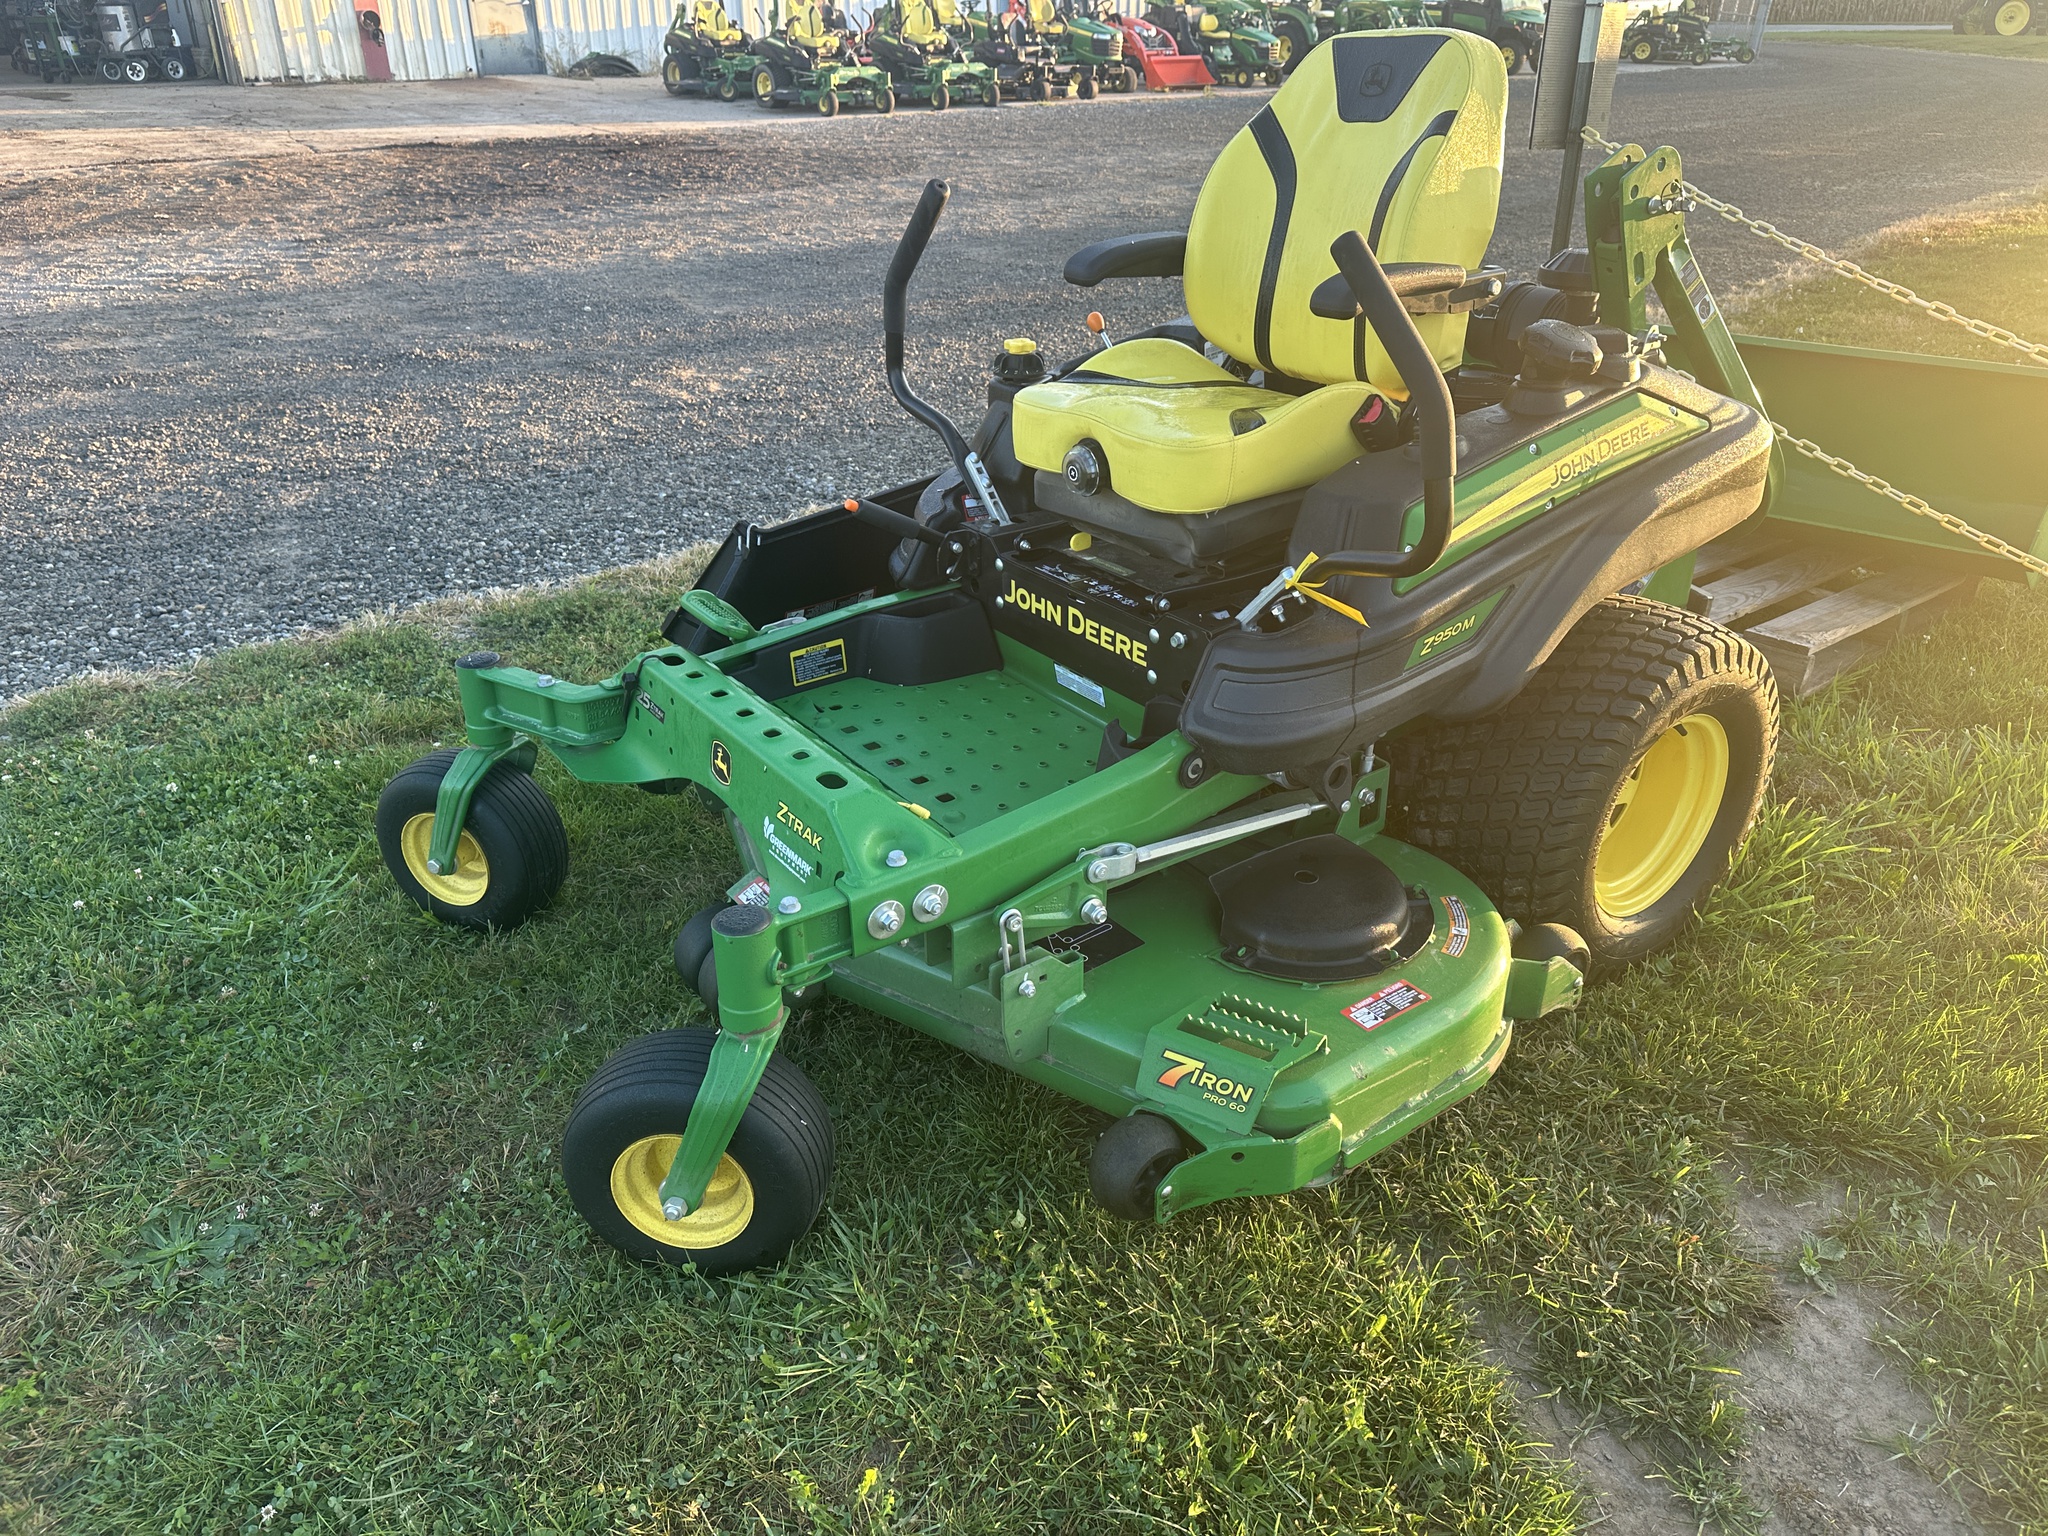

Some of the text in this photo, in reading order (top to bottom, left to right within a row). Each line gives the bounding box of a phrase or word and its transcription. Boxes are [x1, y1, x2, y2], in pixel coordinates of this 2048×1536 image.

[1549, 420, 1652, 489] JOHN DEERE
[1003, 578, 1063, 627] JOHN
[1067, 604, 1149, 668] DEERE
[1419, 614, 1476, 657] Z950M
[775, 800, 824, 852] ZTRAK
[769, 833, 811, 876] GREENMARK
[1202, 1091, 1247, 1114] PRO 60
